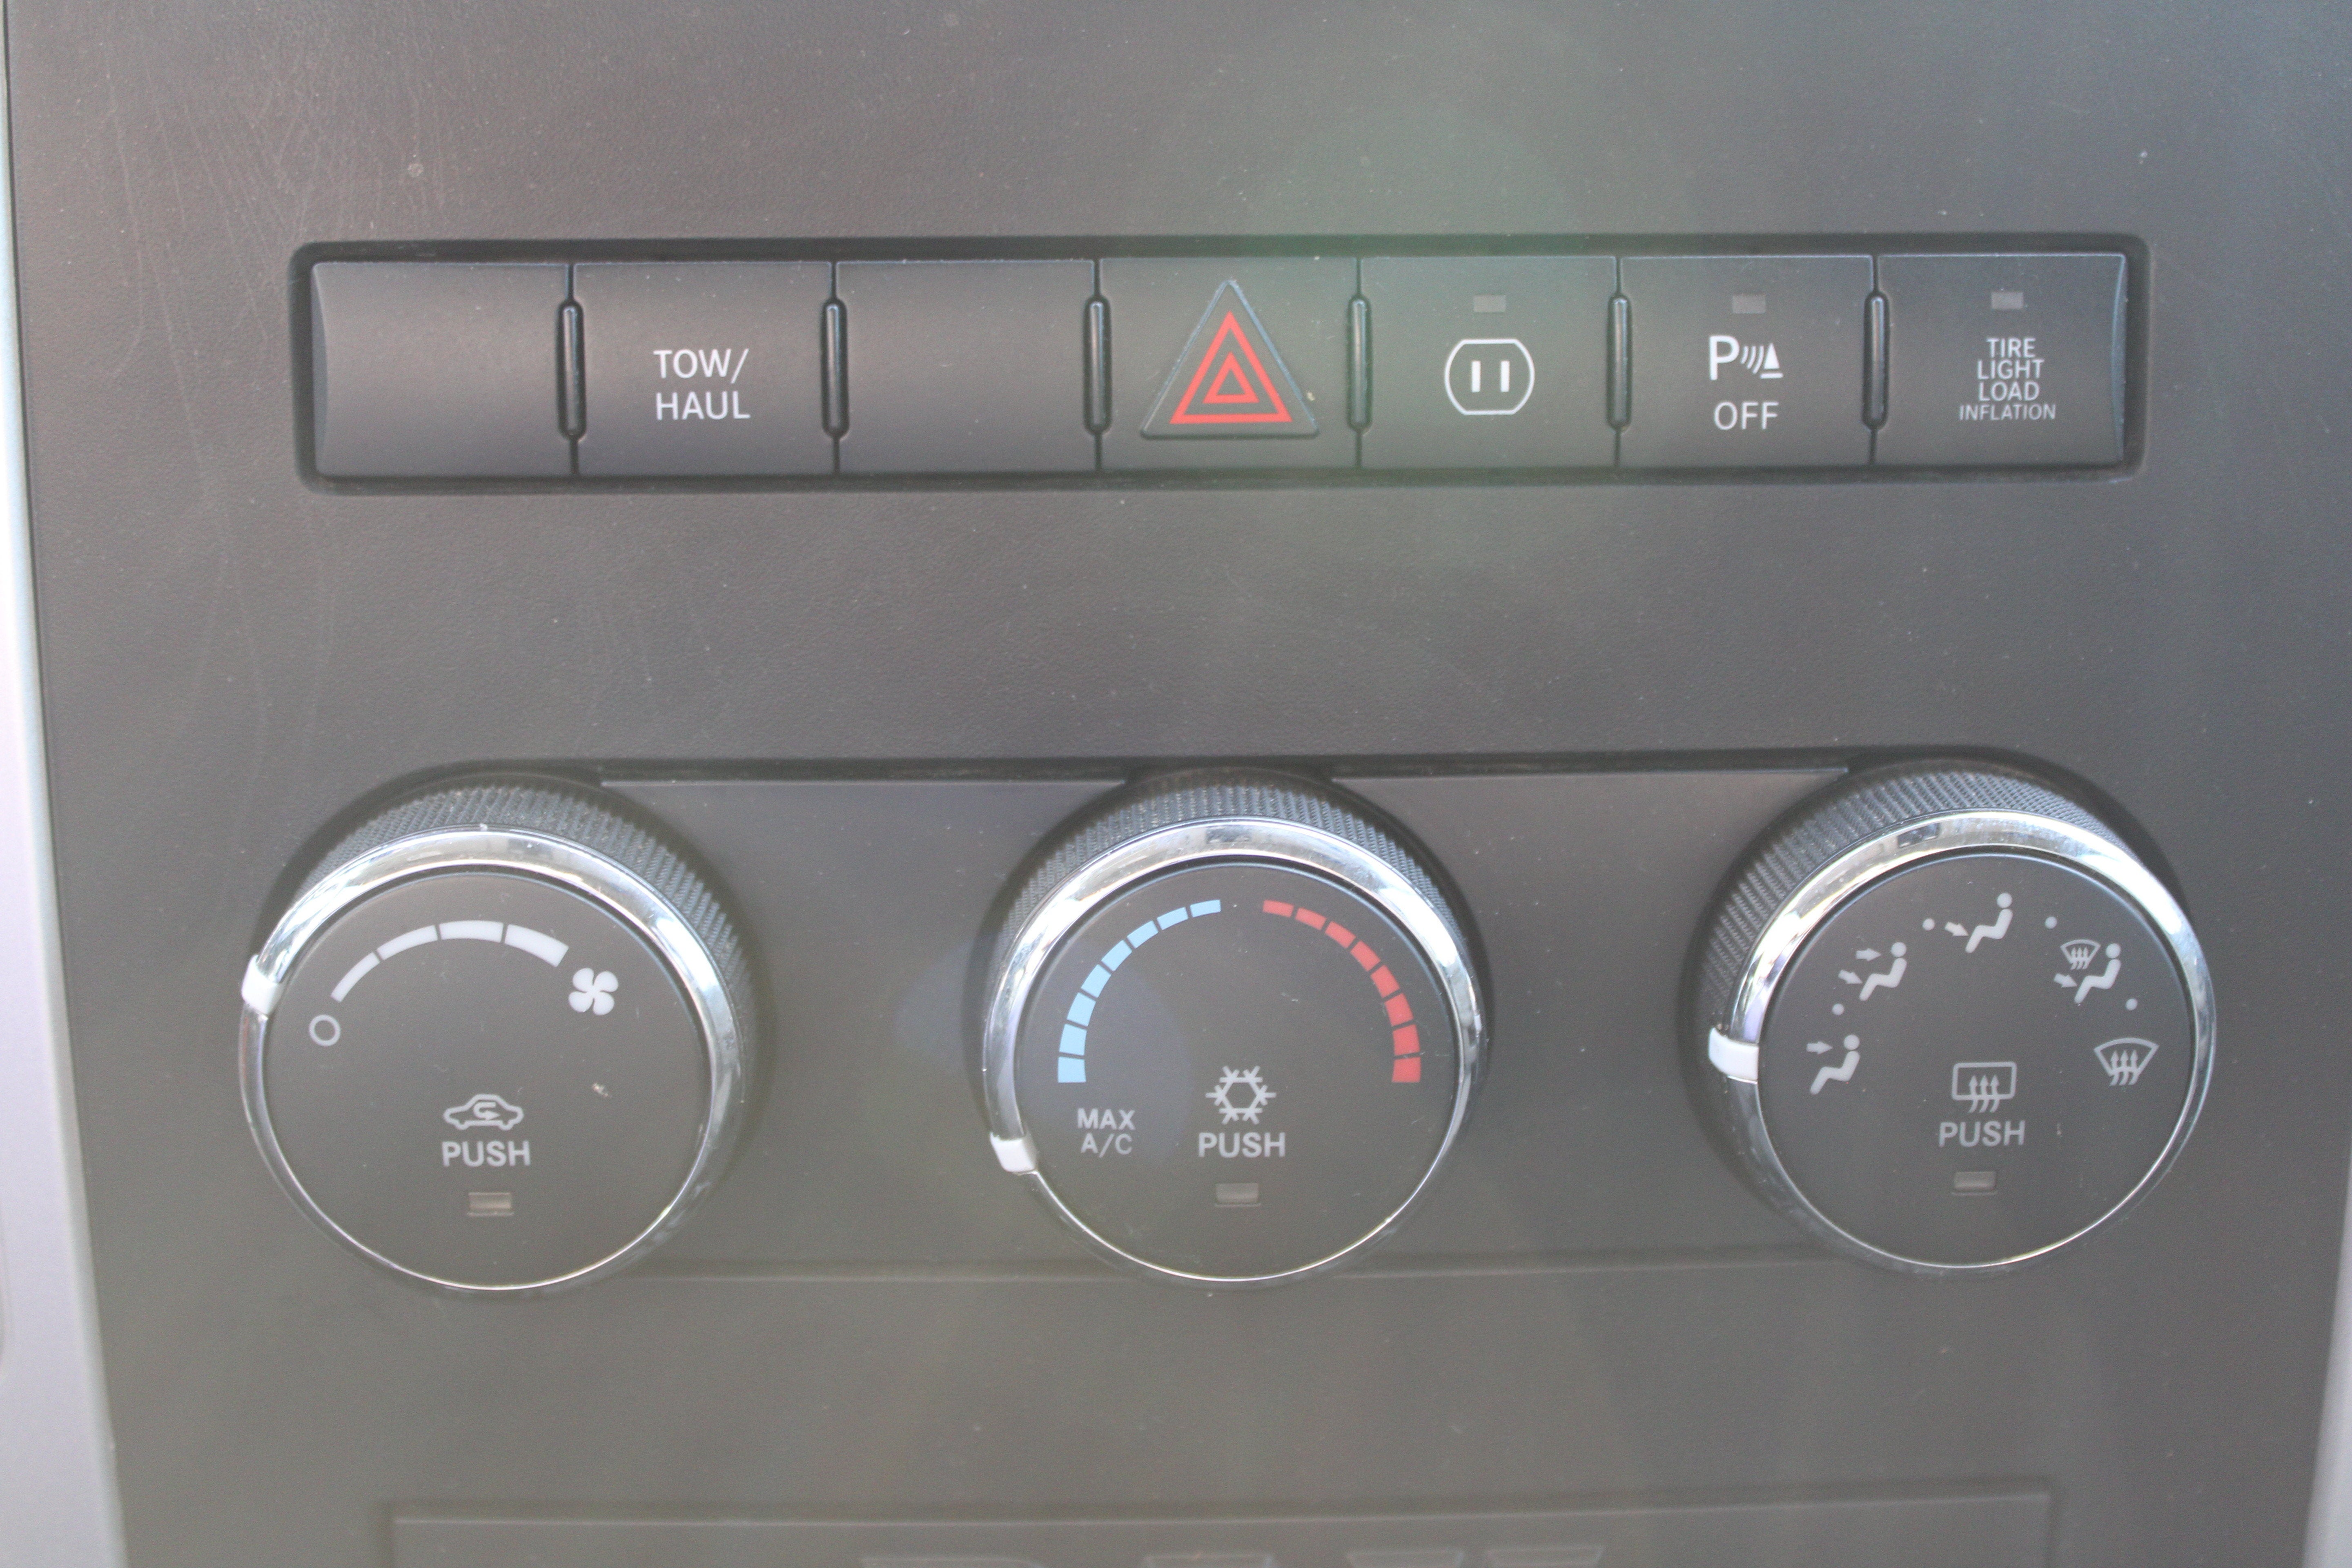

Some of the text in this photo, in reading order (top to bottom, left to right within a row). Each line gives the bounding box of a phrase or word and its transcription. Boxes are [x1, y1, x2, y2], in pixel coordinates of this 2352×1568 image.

[1987, 337, 2035, 358] TIRE
[653, 348, 748, 383] TOW/
[1977, 359, 2044, 380] LIGHT
[1978, 381, 2040, 401] LOAD
[656, 390, 750, 420] HAUL
[1714, 401, 1779, 430] OFF
[1960, 403, 2056, 420] INFLATION
[1077, 1108, 1135, 1129] MAX
[1081, 1132, 1132, 1157] A/C
[1198, 1131, 1285, 1158] PUSH
[1939, 1120, 2025, 1147] PUSH
[441, 1140, 531, 1167] PUSH
